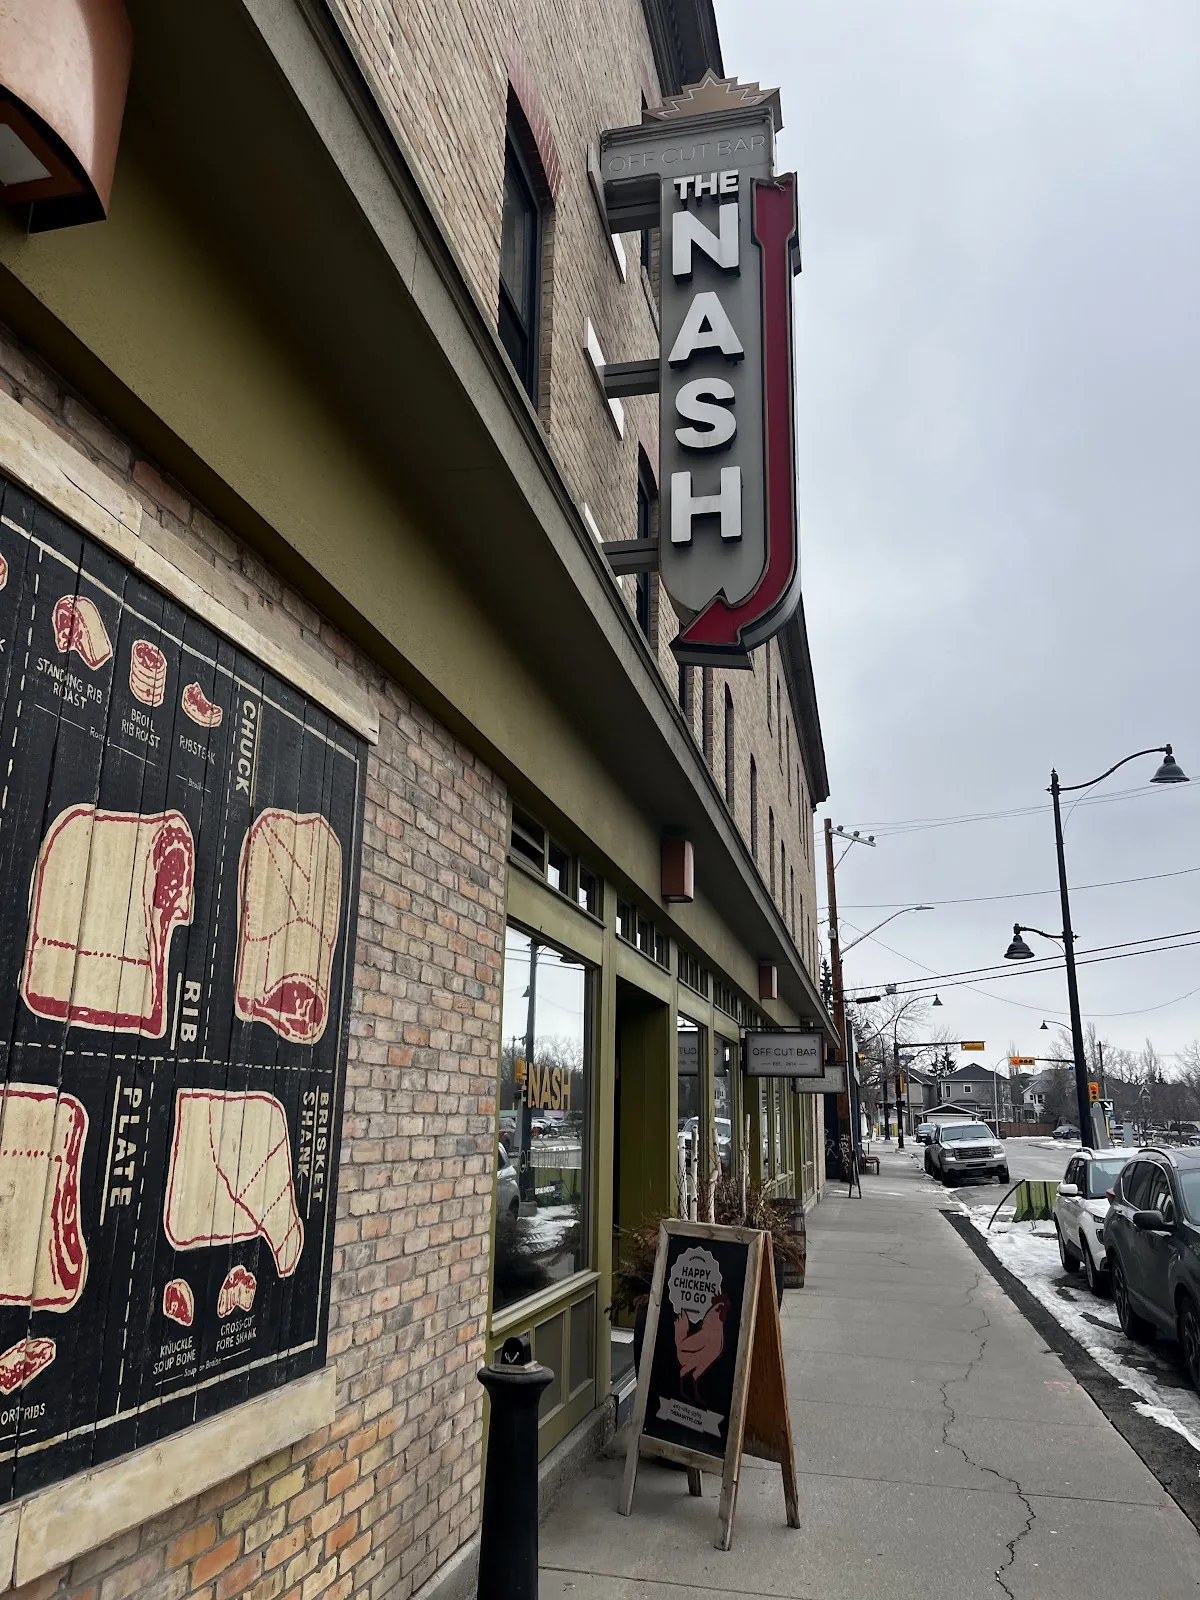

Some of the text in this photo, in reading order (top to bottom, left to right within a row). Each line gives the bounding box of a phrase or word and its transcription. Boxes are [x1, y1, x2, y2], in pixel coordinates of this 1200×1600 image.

[608, 135, 766, 172] OFF CUT BAR
[673, 169, 739, 201] THE
[667, 202, 745, 544] NASH
[36, 657, 103, 704] STANDING RIB
[52, 682, 88, 710] ROAST
[121, 718, 161, 749] RIB ROAST
[131, 708, 156, 733] BROIL
[235, 700, 257, 796] CHUCK
[180, 980, 201, 1043] RIB
[752, 1047, 817, 1057] OFF CUT BAR
[527, 1062, 573, 1111] NASH
[109, 1087, 143, 1208] PLATE
[297, 1091, 315, 1179] SHANK
[312, 1091, 330, 1203] BRISKET
[673, 1277, 717, 1294] CHICKENS
[681, 1266, 712, 1280] HAPPY
[680, 1290, 707, 1304] TO GO
[159, 1335, 194, 1359] KNUCKLE
[215, 1327, 257, 1353] FORE SHANK
[152, 1349, 197, 1375] SOUP BONE
